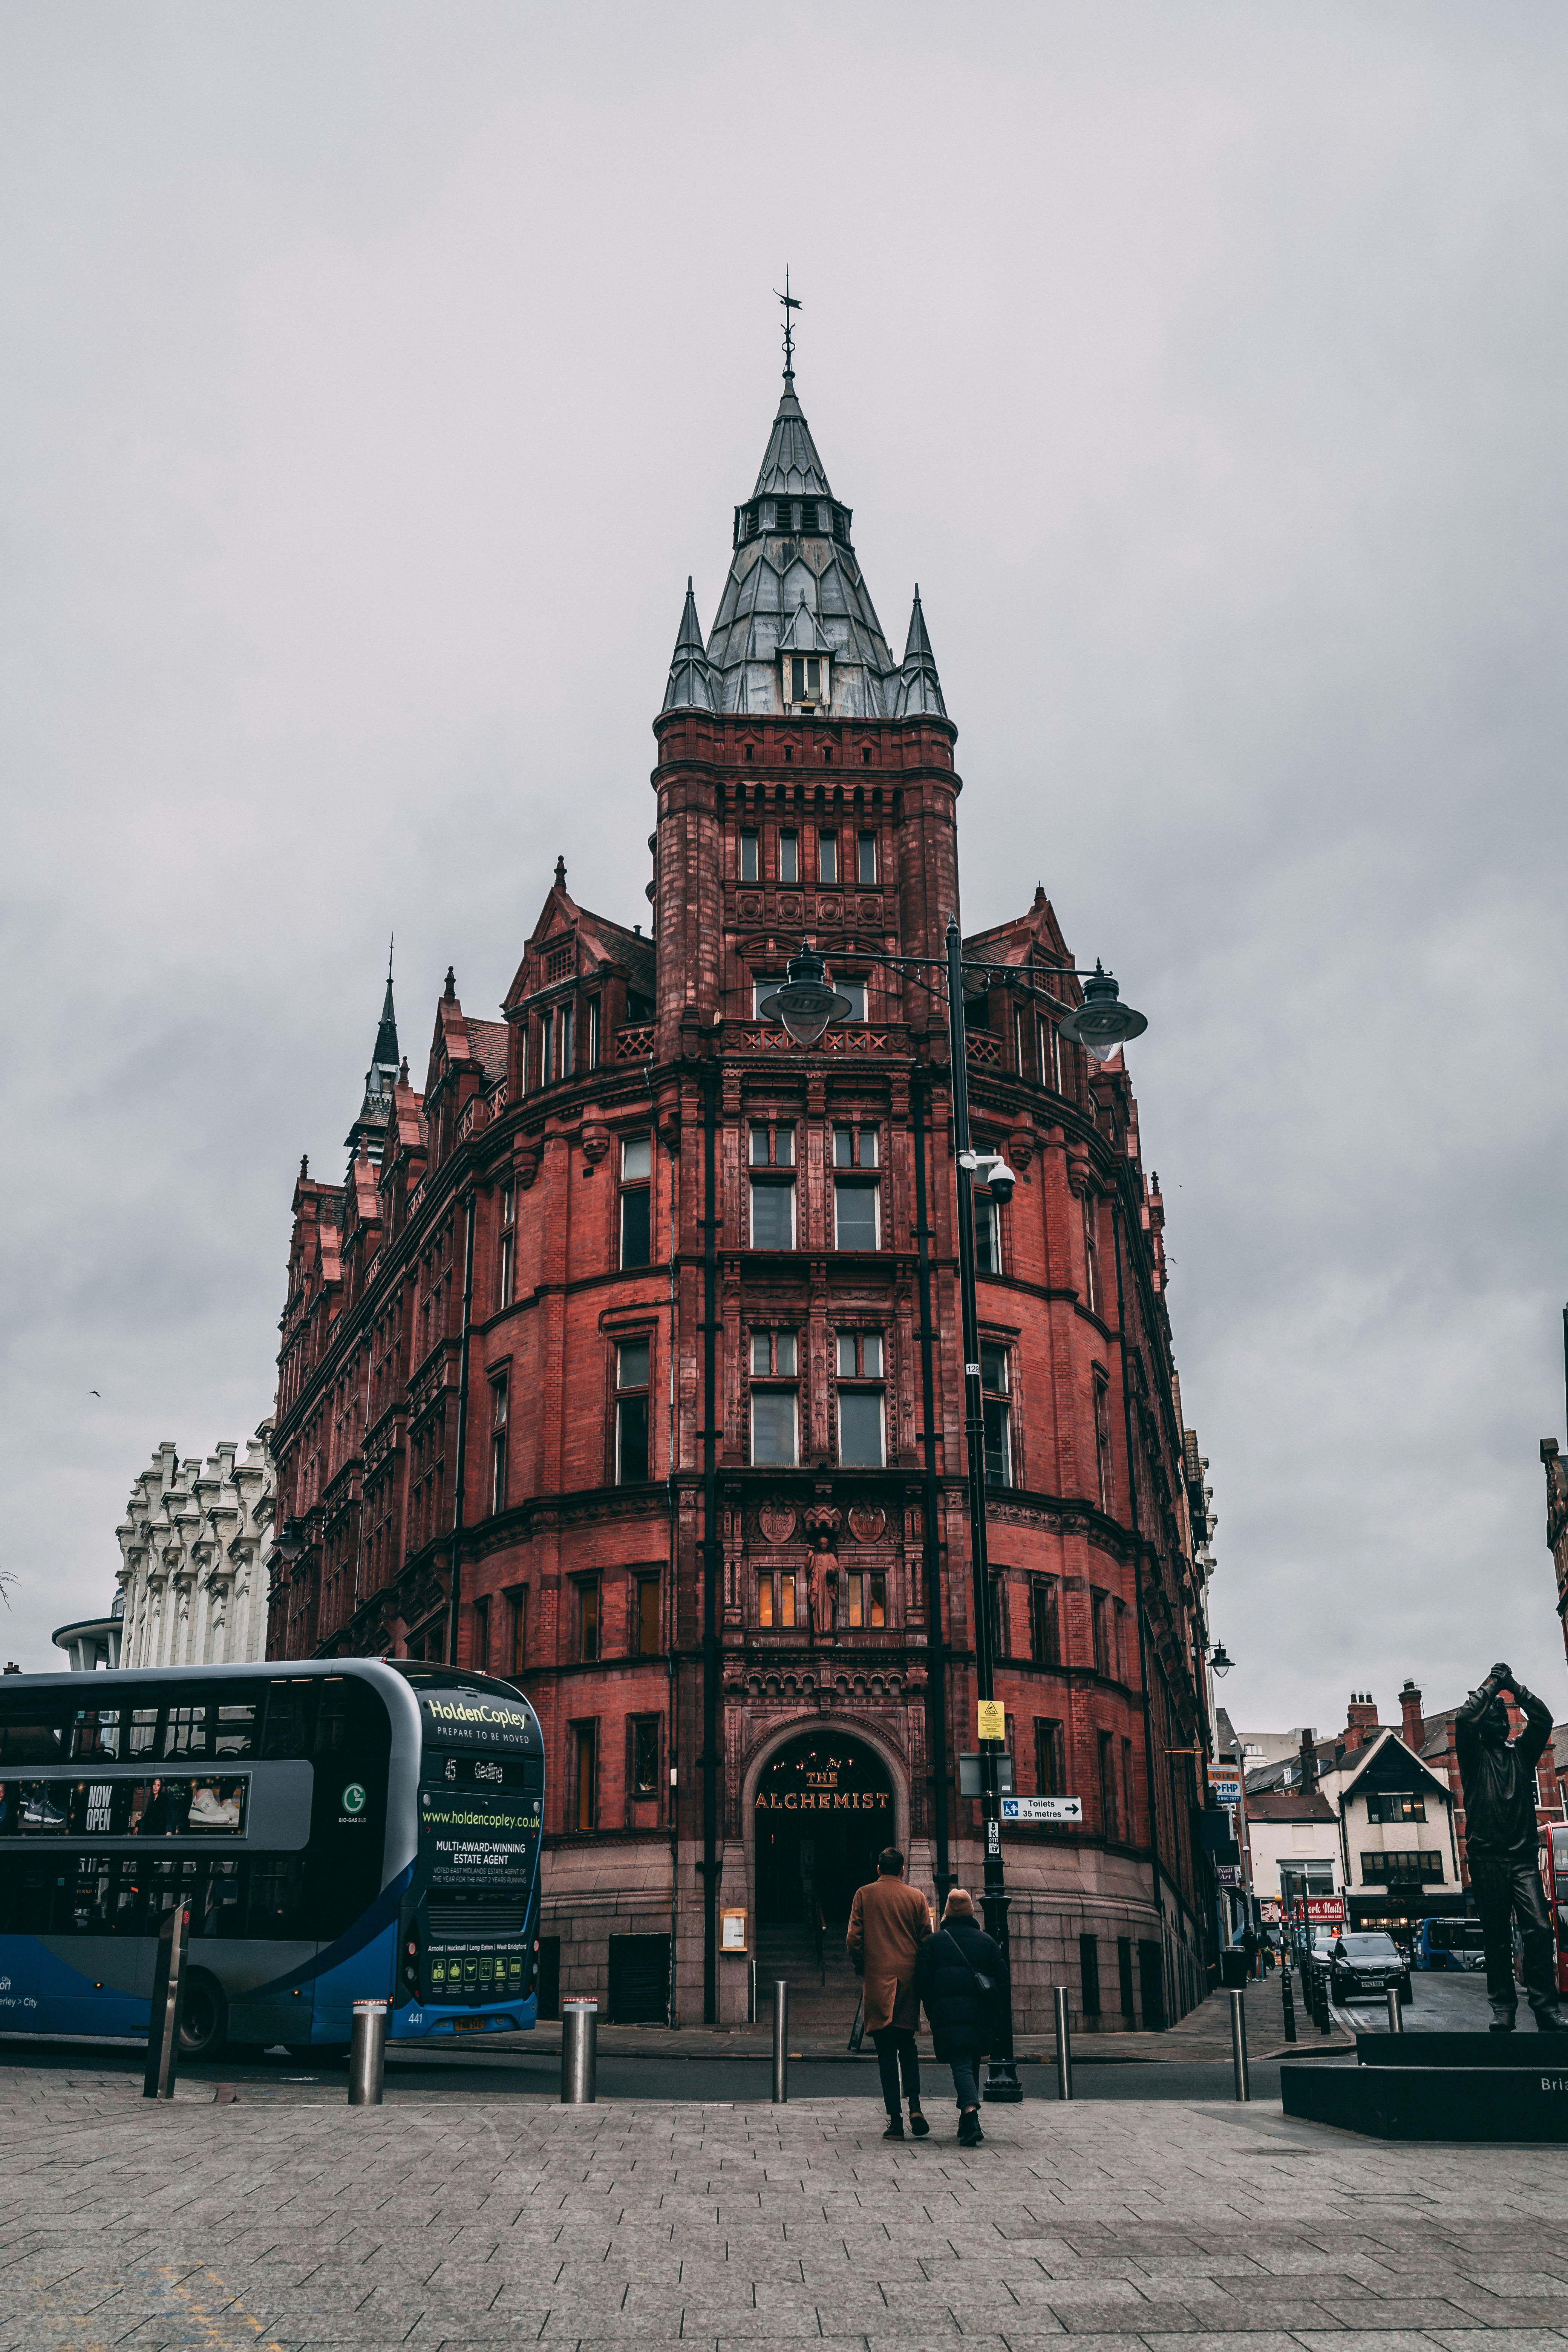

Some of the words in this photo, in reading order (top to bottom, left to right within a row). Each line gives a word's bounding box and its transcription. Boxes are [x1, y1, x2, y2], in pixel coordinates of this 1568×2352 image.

[428, 1700, 525, 1730] HoldenCopley
[437, 1727, 473, 1738] PREPARE
[476, 1730, 487, 1739] TO
[491, 1732, 499, 1741] BE
[503, 1734, 529, 1743] MOVED
[445, 1759, 456, 1780] 45
[806, 1772, 838, 1783] THE
[1221, 1783, 1238, 1792] FHP
[88, 1785, 113, 1808] NOW
[755, 1793, 890, 1809] ALCHEMIST
[86, 1808, 111, 1831] OPEN
[423, 1810, 540, 1829] www.holdencopley.co.uk
[436, 1841, 525, 1853] MULTI-AWARD-WINNING
[454, 1854, 481, 1864] ESTATE
[483, 1855, 509, 1865] AGENT
[1322, 1902, 1342, 1914] Nails
[23, 1997, 38, 2009] City
[408, 2013, 423, 2024] 441
